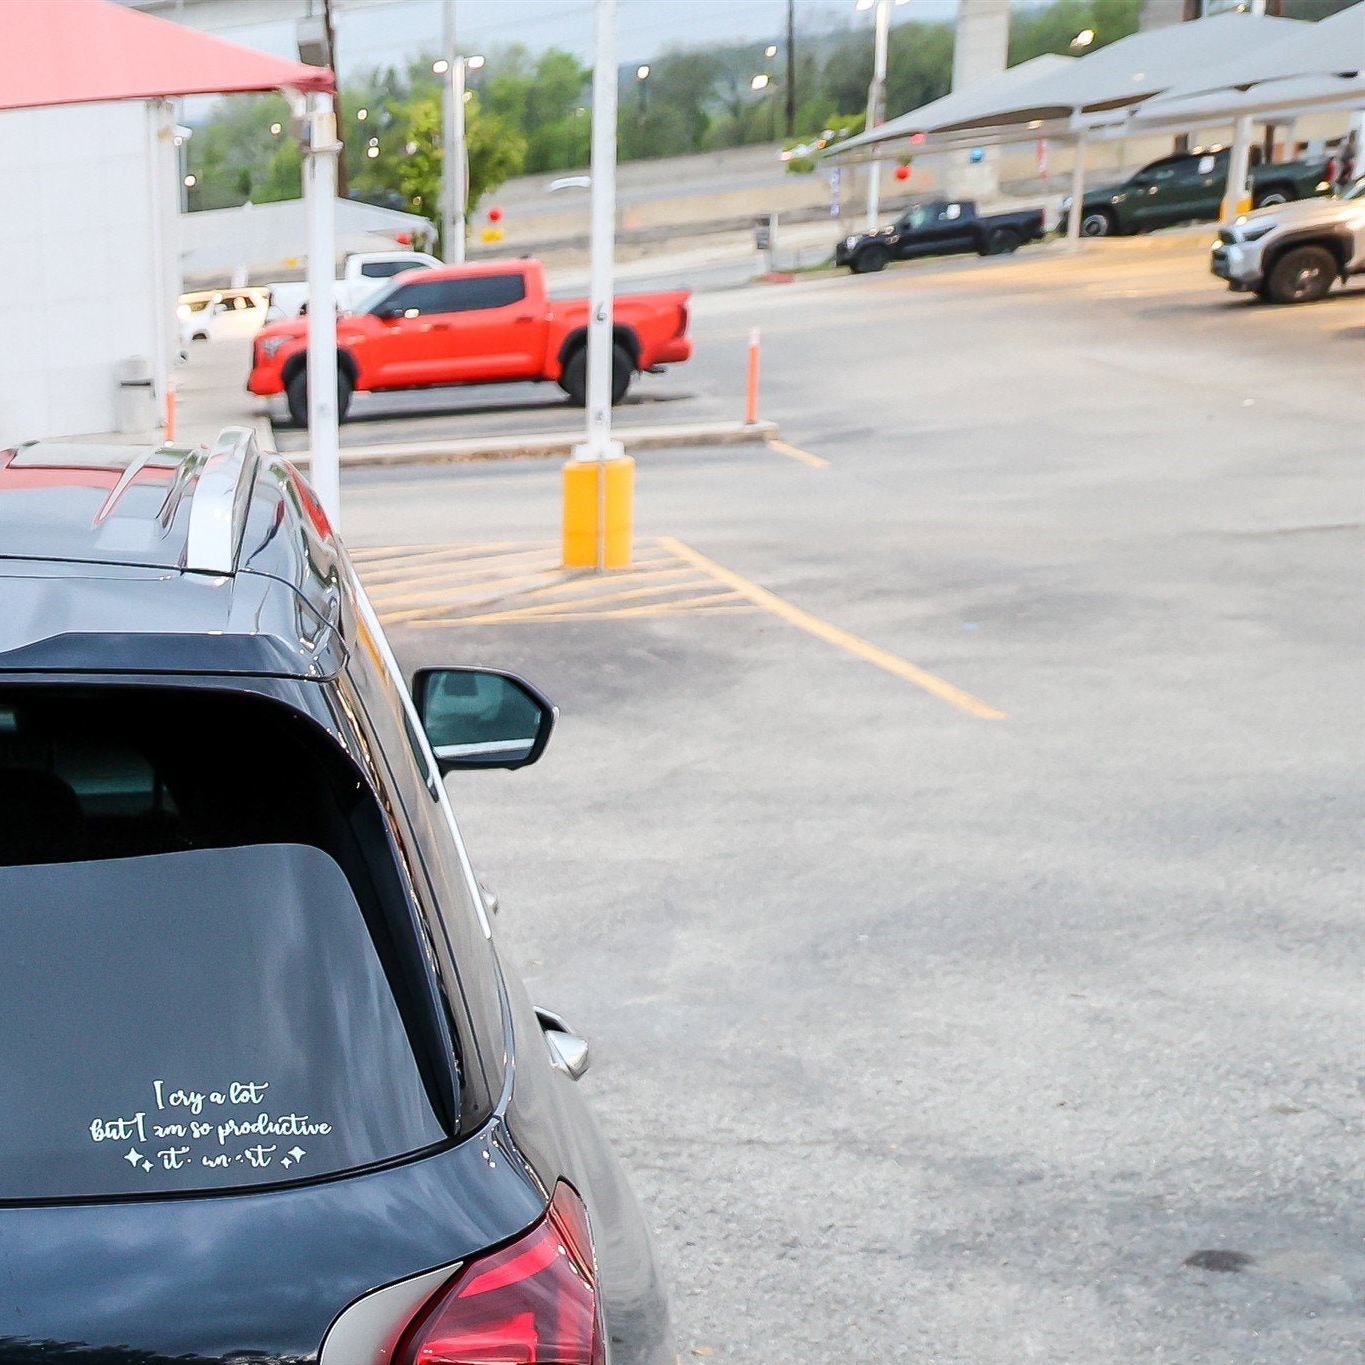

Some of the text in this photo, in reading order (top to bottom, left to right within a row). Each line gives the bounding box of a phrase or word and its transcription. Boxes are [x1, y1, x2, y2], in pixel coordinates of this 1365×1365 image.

[153, 1080, 269, 1114] I cry a lot
[89, 1117, 139, 1142] but
[135, 1112, 147, 1142] I
[189, 1121, 214, 1136] so
[217, 1113, 332, 1145] productive
